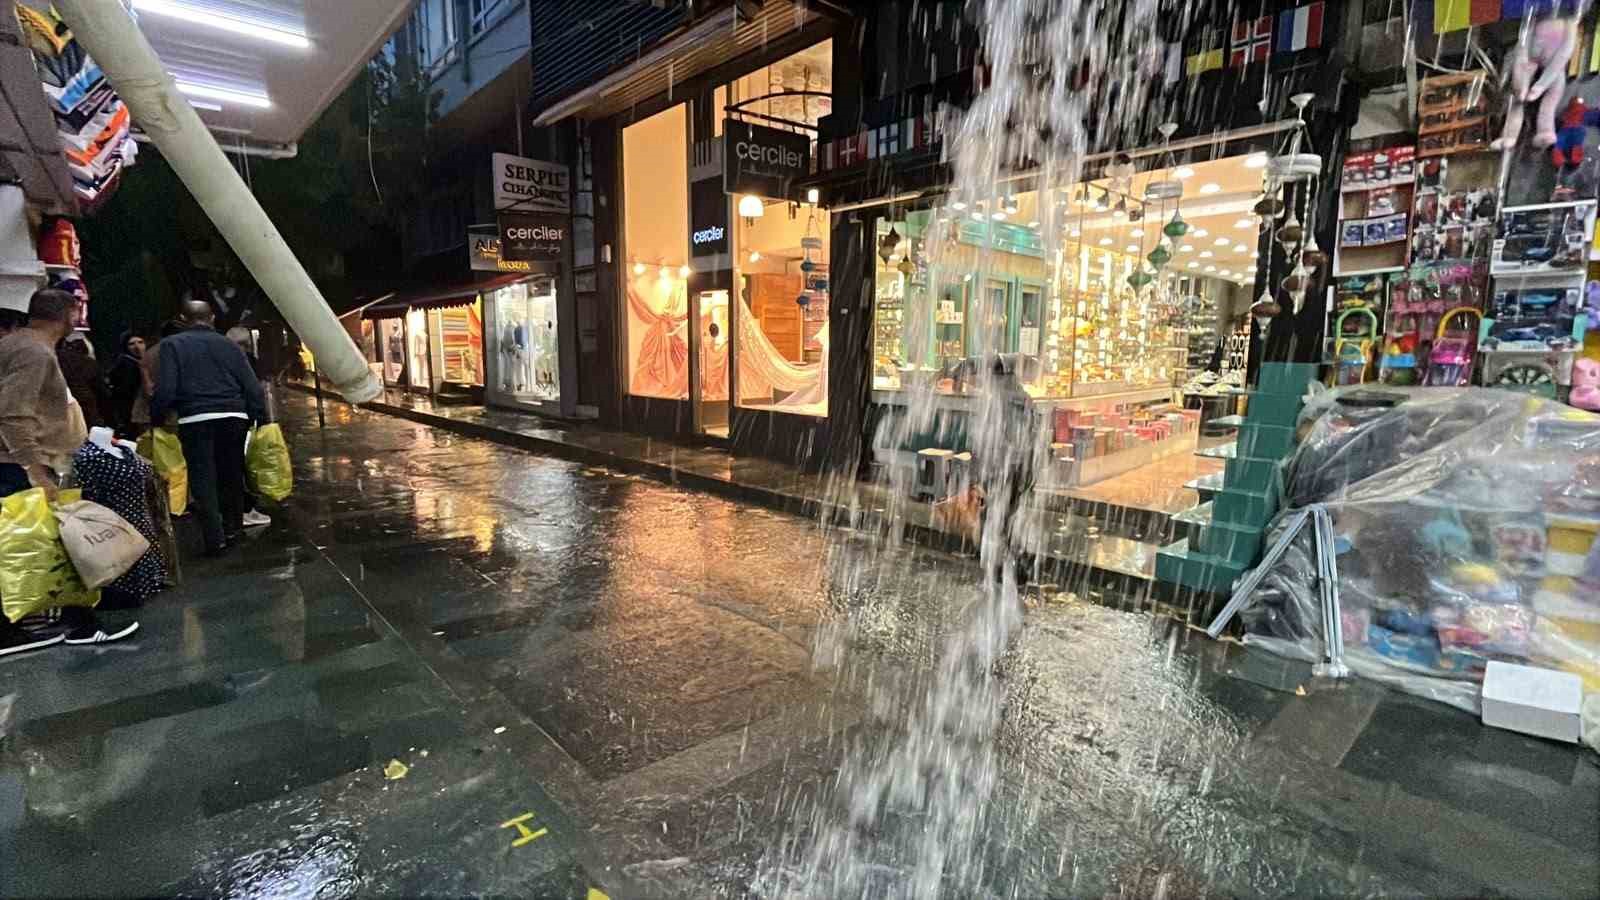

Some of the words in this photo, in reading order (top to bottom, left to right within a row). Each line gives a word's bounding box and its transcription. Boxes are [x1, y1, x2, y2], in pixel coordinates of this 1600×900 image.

[735, 141, 804, 168] cerciler
[506, 225, 563, 241] cerciler
[692, 225, 724, 245] cerciler
